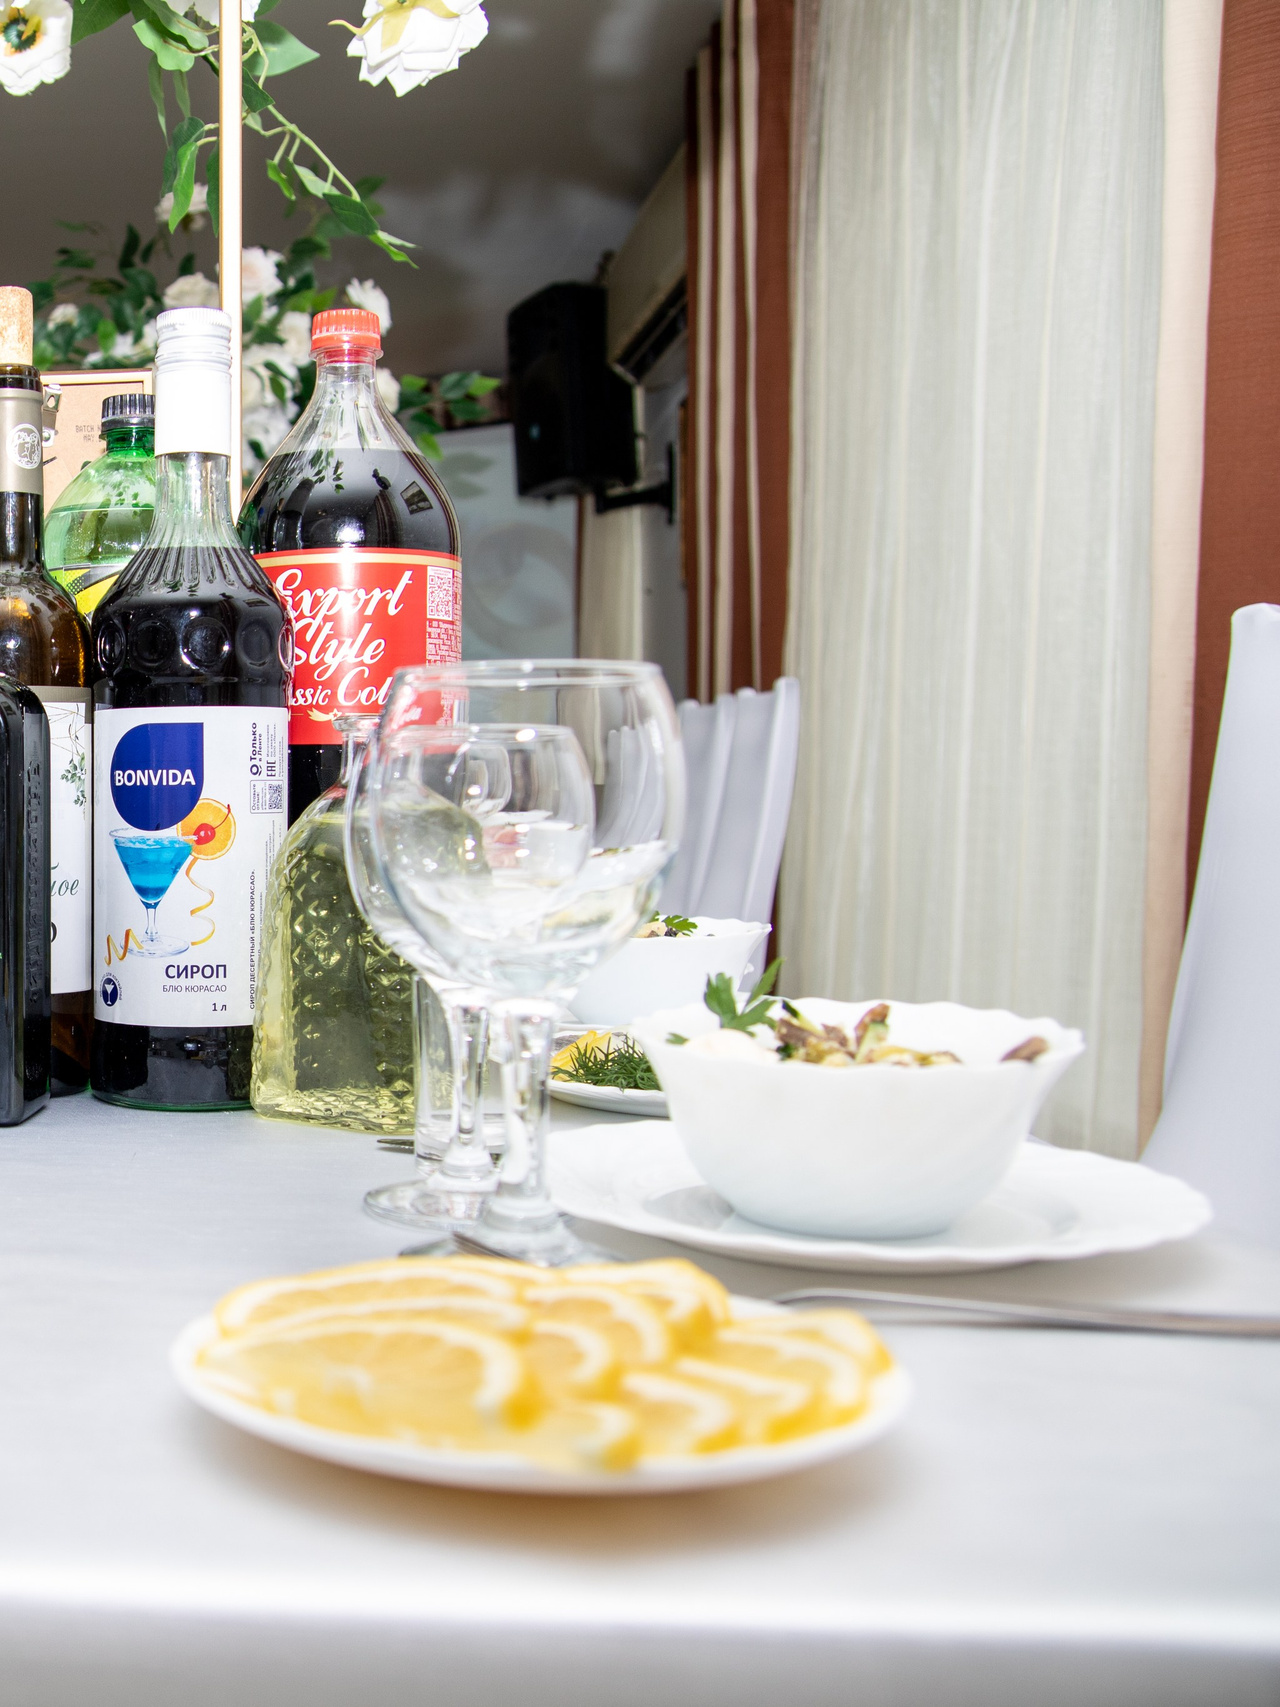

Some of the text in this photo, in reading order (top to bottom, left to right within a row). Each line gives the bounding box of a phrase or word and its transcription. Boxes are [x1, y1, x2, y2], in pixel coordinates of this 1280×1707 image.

[275, 568, 413, 630] Export
[293, 617, 386, 682] Style
[291, 666, 394, 706] ssic Col
[114, 768, 197, 788] BONVIDA
[165, 964, 227, 979] СИРОП
[162, 984, 227, 993] БЛЮ КЮРАСАО
[211, 1002, 218, 1011] 1
